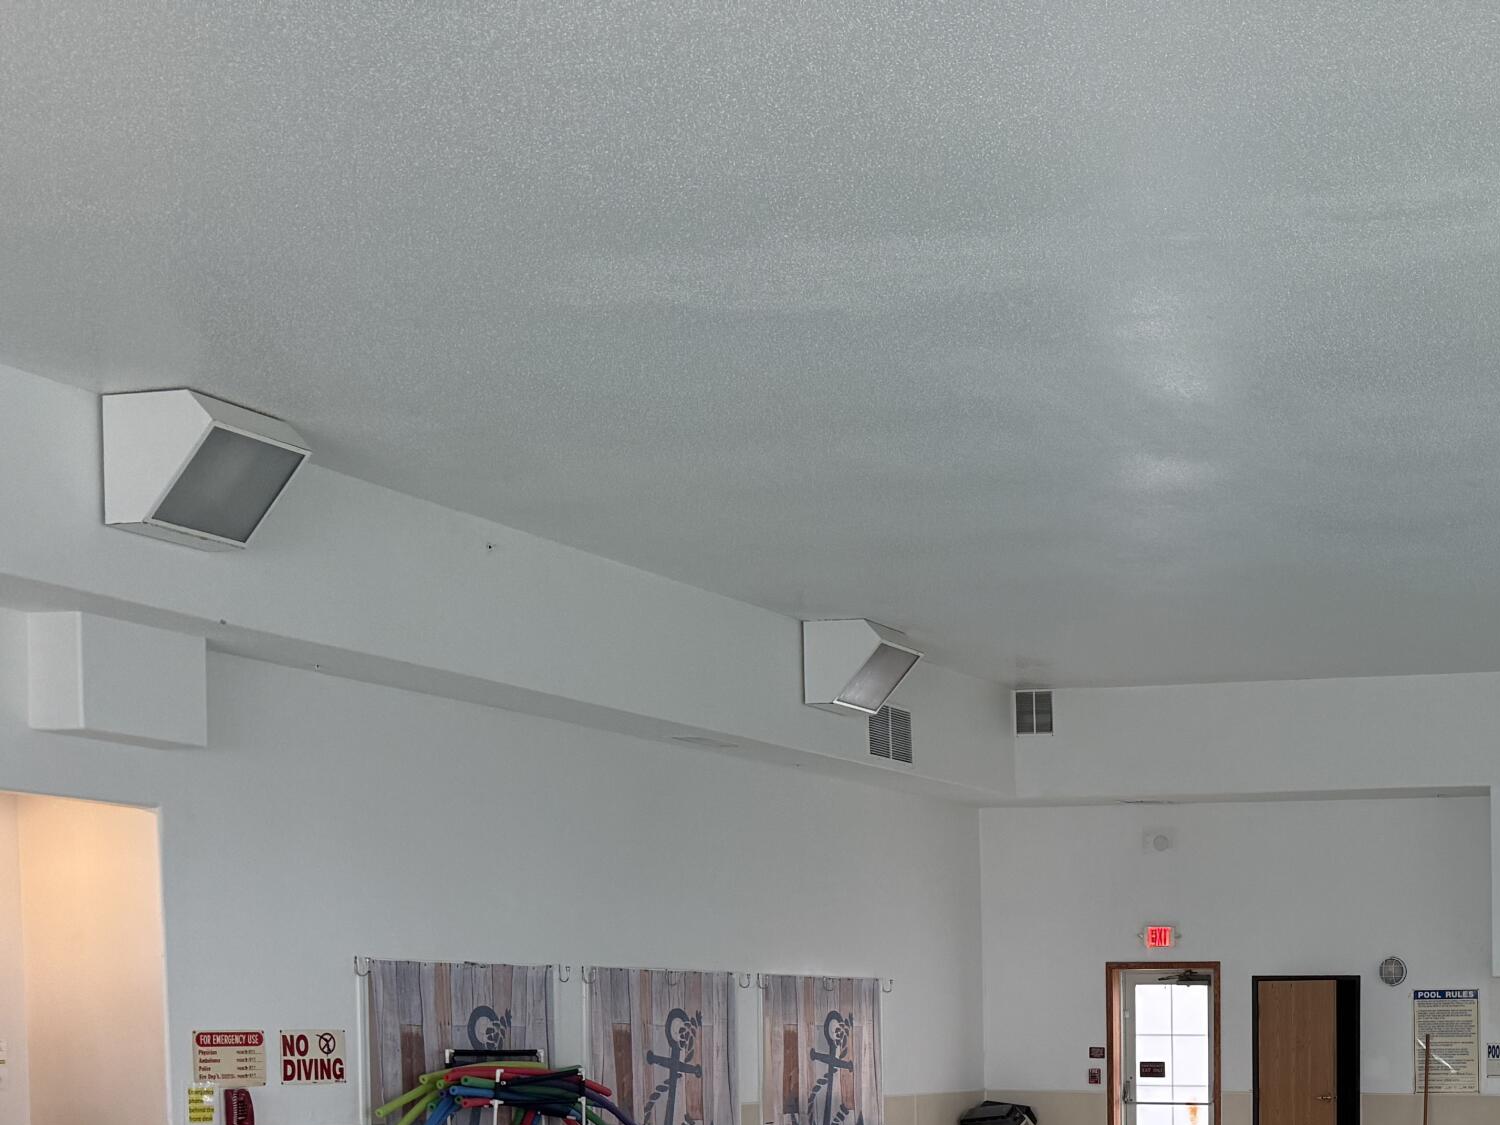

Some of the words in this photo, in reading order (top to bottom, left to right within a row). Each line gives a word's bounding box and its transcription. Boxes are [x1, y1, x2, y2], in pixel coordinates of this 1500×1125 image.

[1149, 927, 1171, 946] EXIT
[200, 1034, 211, 1044] FOR
[213, 1034, 246, 1044] EMERGENCY
[248, 1034, 259, 1044] USE
[282, 1034, 309, 1057] NO
[283, 1058, 345, 1081] DIVING
